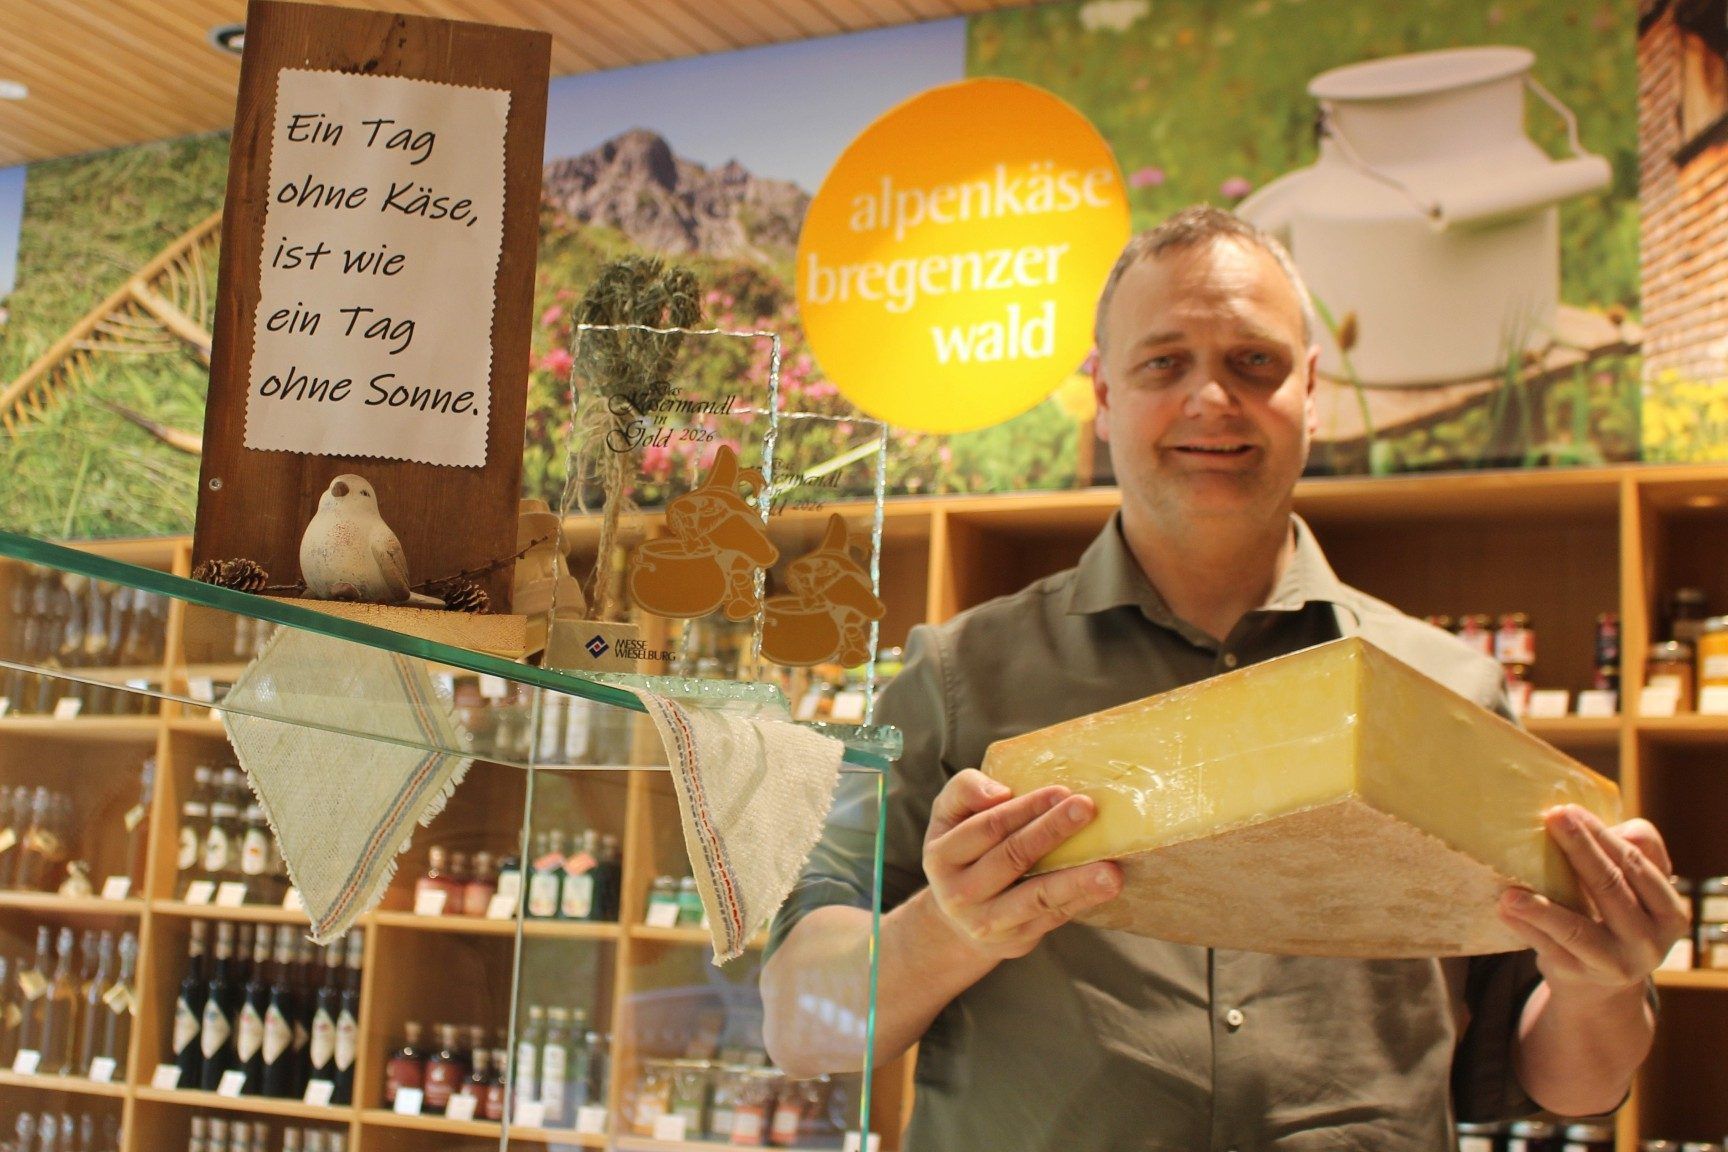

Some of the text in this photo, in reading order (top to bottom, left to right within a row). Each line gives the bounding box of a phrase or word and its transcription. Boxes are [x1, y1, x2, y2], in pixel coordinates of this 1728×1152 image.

[286, 113, 436, 165] Ein Tag
[276, 174, 478, 227] ohne Käse,
[849, 160, 1114, 242] alpenkäse
[272, 236, 406, 276] ist wie
[806, 242, 1069, 313] bregenzer
[265, 302, 416, 355] ein Tag
[930, 300, 1056, 364] wald
[259, 366, 479, 416] ohne Sonne.
[606, 420, 719, 453] Gold 2026
[614, 638, 648, 650] MESSE
[614, 648, 676, 661] WIESELBURG
